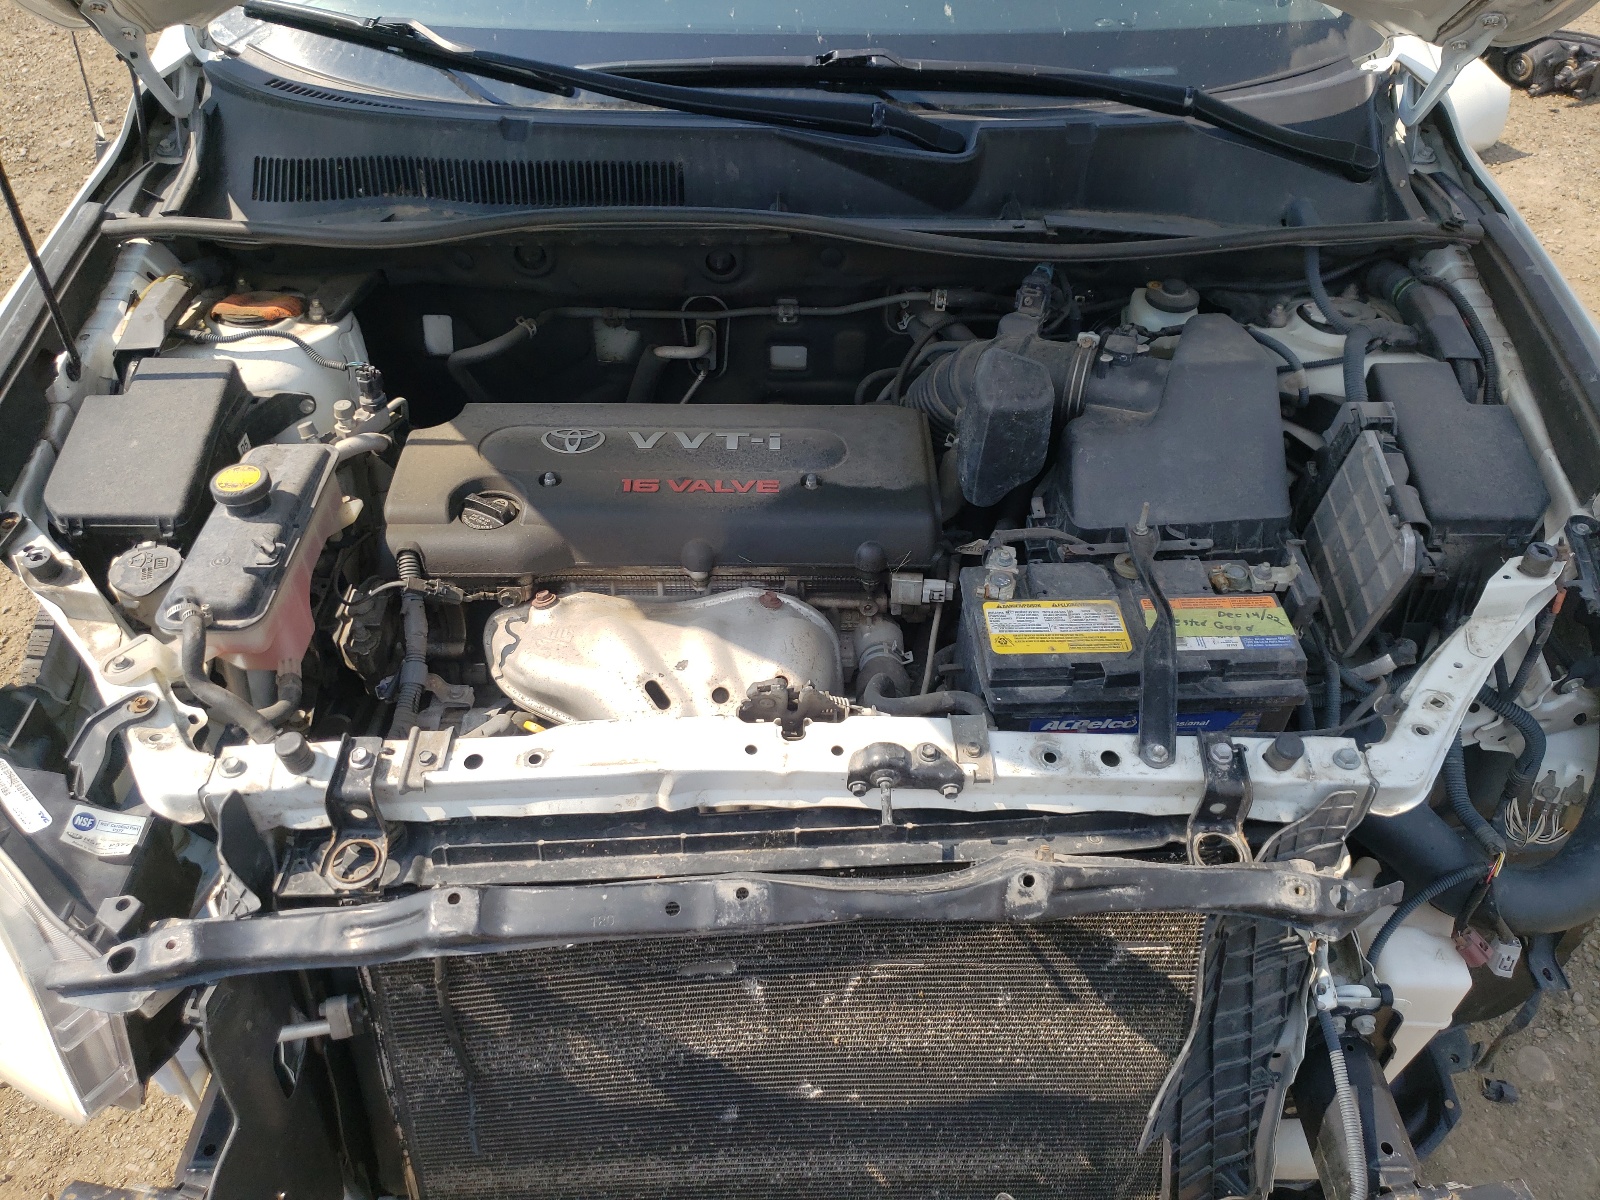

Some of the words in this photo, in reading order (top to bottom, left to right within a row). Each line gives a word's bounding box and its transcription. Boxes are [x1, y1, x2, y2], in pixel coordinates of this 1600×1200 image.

[627, 431, 782, 451] VVT-i
[621, 478, 660, 494] 16
[667, 479, 781, 494] VALVE
[1174, 618, 1208, 627] ested
[1213, 621, 1255, 632] Good
[1217, 610, 1242, 619] Dec
[1245, 609, 1287, 627] 14/22
[74, 815, 95, 828] NSF
